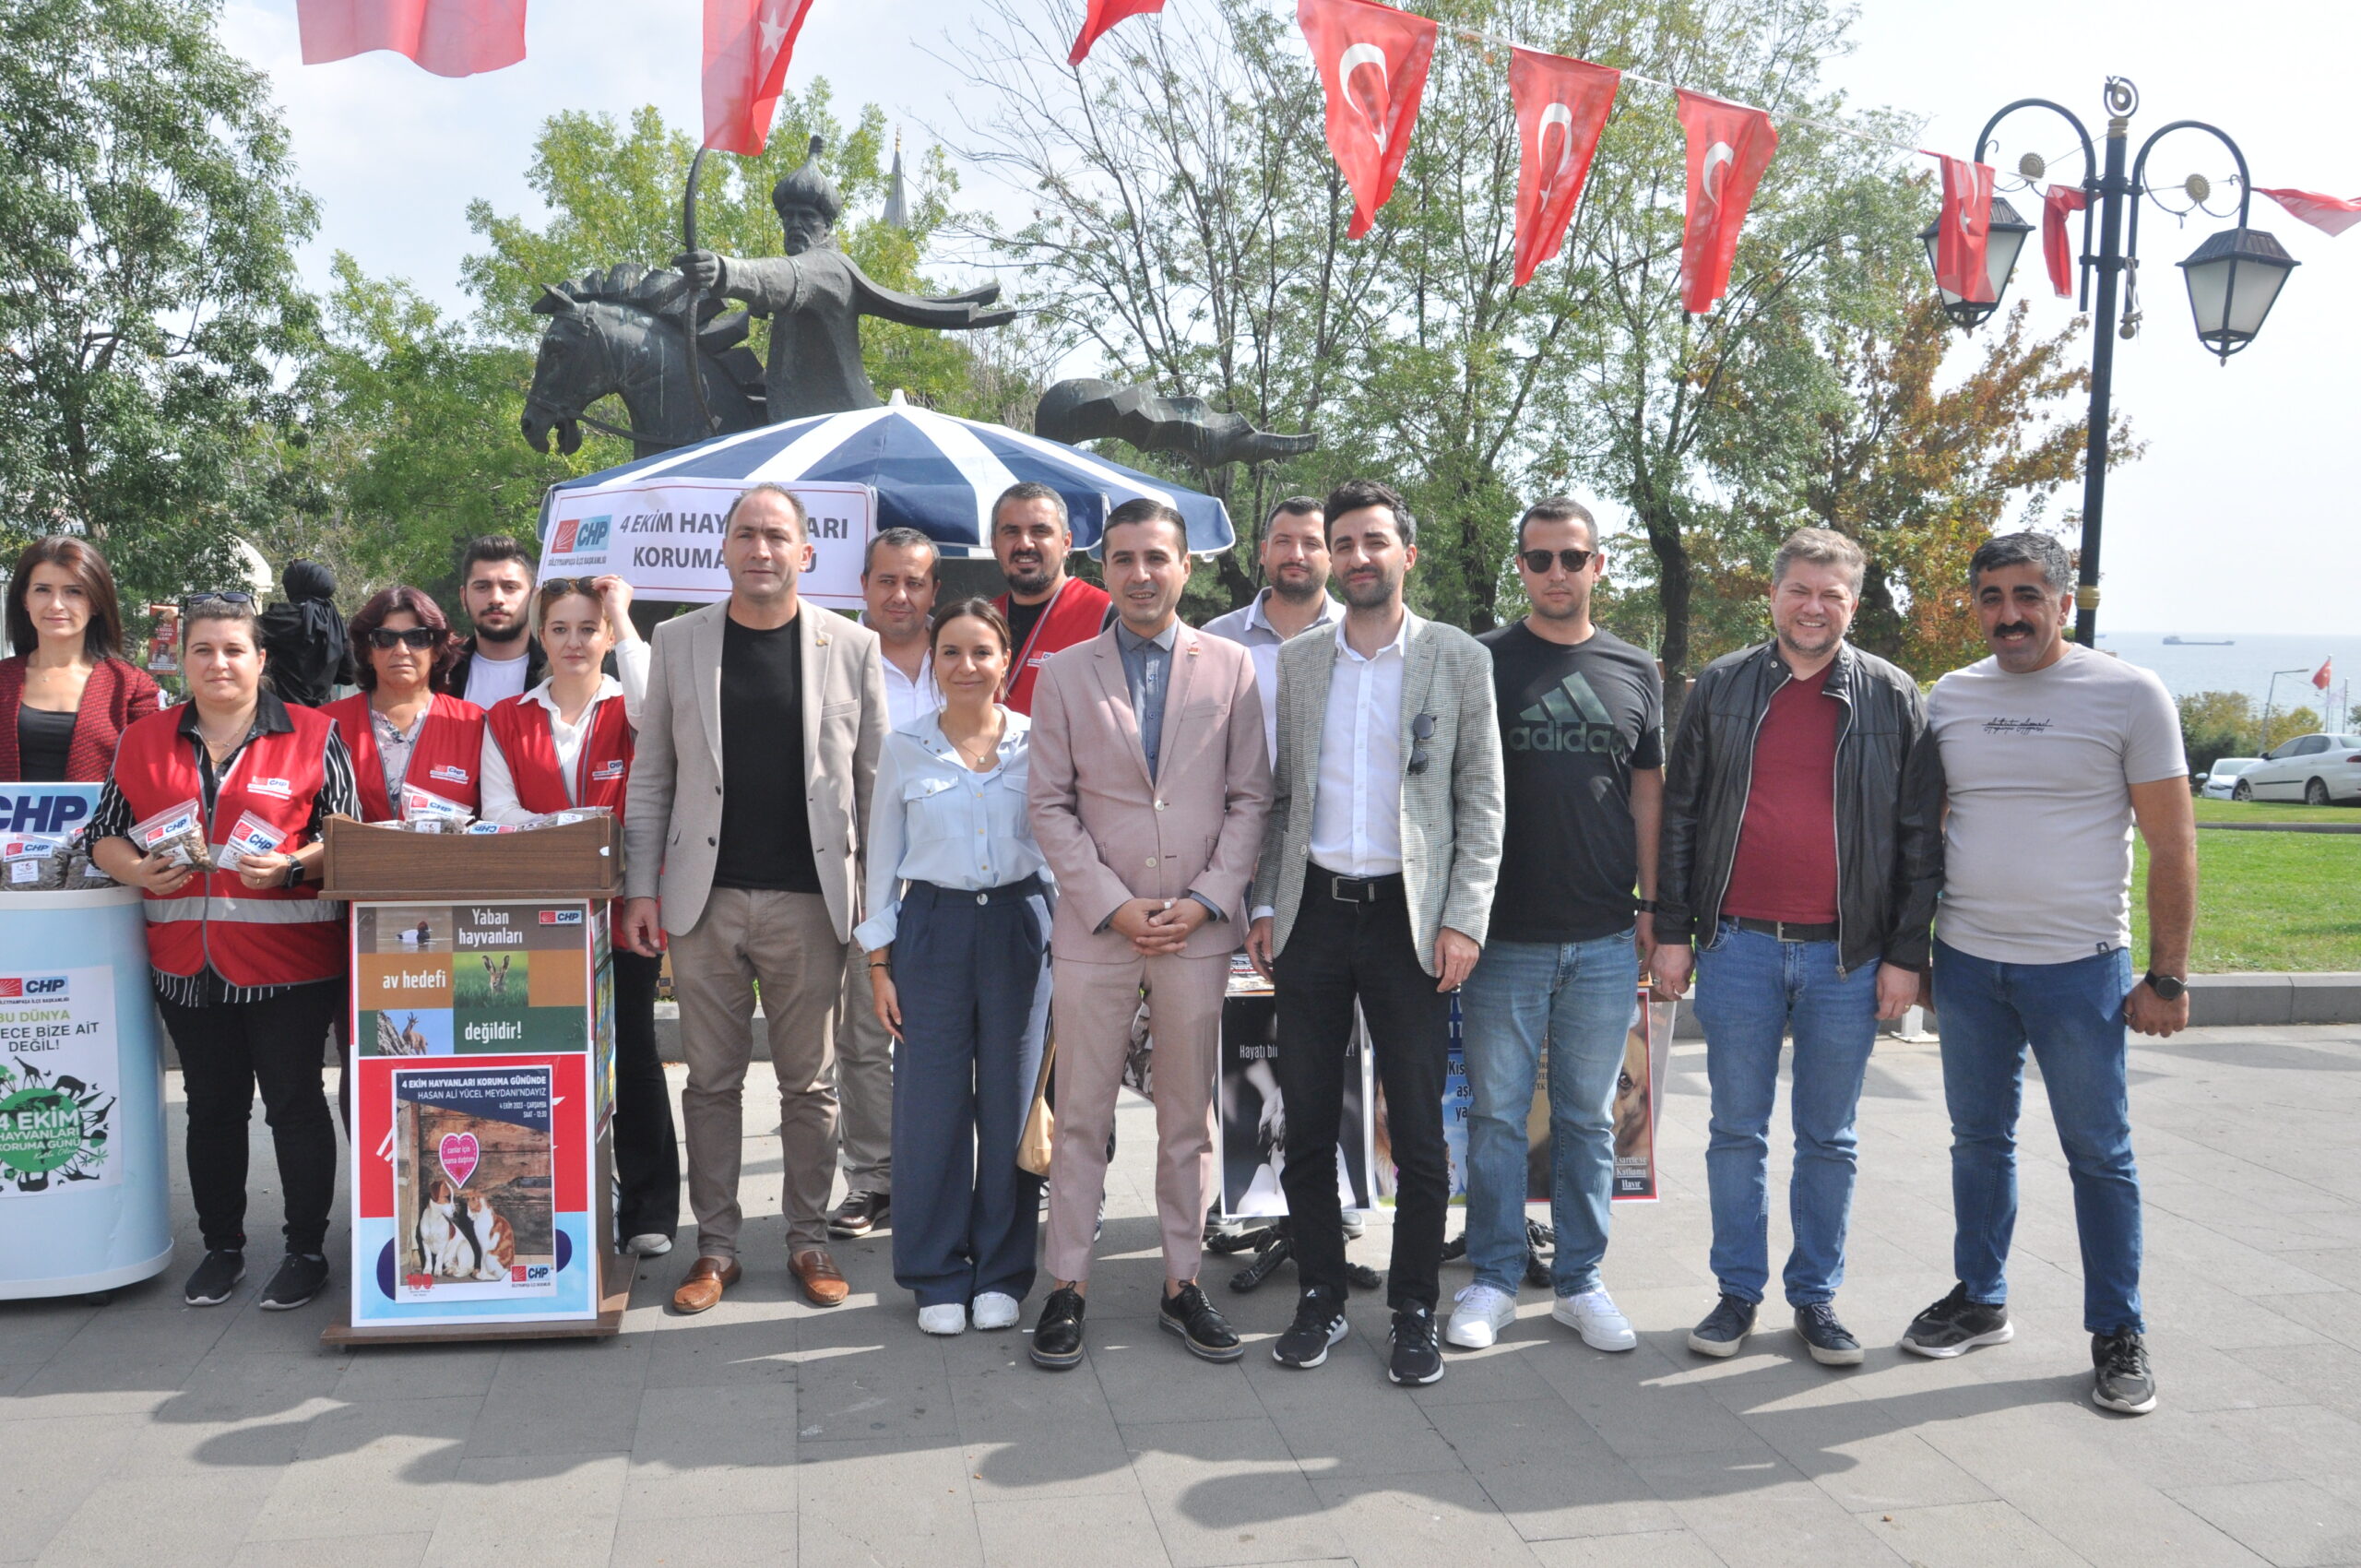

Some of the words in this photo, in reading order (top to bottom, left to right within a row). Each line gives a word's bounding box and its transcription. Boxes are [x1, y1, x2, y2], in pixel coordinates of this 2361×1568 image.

[620, 516, 631, 533] 4
[631, 509, 673, 533] EKİM
[680, 513, 848, 540] HAYARI
[577, 521, 608, 546] CHP
[1508, 720, 1625, 754] adidas
[165, 818, 187, 833] CHP
[249, 834, 273, 850] CHP
[472, 909, 509, 925] Yaban
[557, 913, 578, 921] CHP
[458, 928, 523, 948] hayvanları
[26, 979, 65, 993] CHP
[383, 974, 398, 989] av
[402, 969, 446, 989] hedefi
[20, 1009, 70, 1022] DÜNYA
[0, 1027, 30, 1039] ECE
[36, 1024, 70, 1038] BİZE
[75, 1021, 99, 1035] AİT
[465, 1021, 522, 1043] değildir!
[8, 1039, 59, 1052] DEĞİL!
[1240, 1044, 1264, 1060] Hayatı
[401, 1079, 407, 1089] 4
[409, 1077, 427, 1088] EKİM
[428, 1077, 475, 1087] HAYVANLARI
[477, 1076, 508, 1087] KORUMA
[510, 1075, 547, 1086] GÜNÜNDE
[418, 1090, 444, 1099] HASAN
[445, 1088, 457, 1099] ALİ
[459, 1088, 483, 1098] YÜCEL
[485, 1087, 547, 1098] MEYDANI'NDAYIZ
[0, 1112, 10, 1131] 4
[17, 1106, 79, 1130] EKİM
[47, 1136, 80, 1149] GÜNÜ
[528, 1267, 549, 1279] CHP
